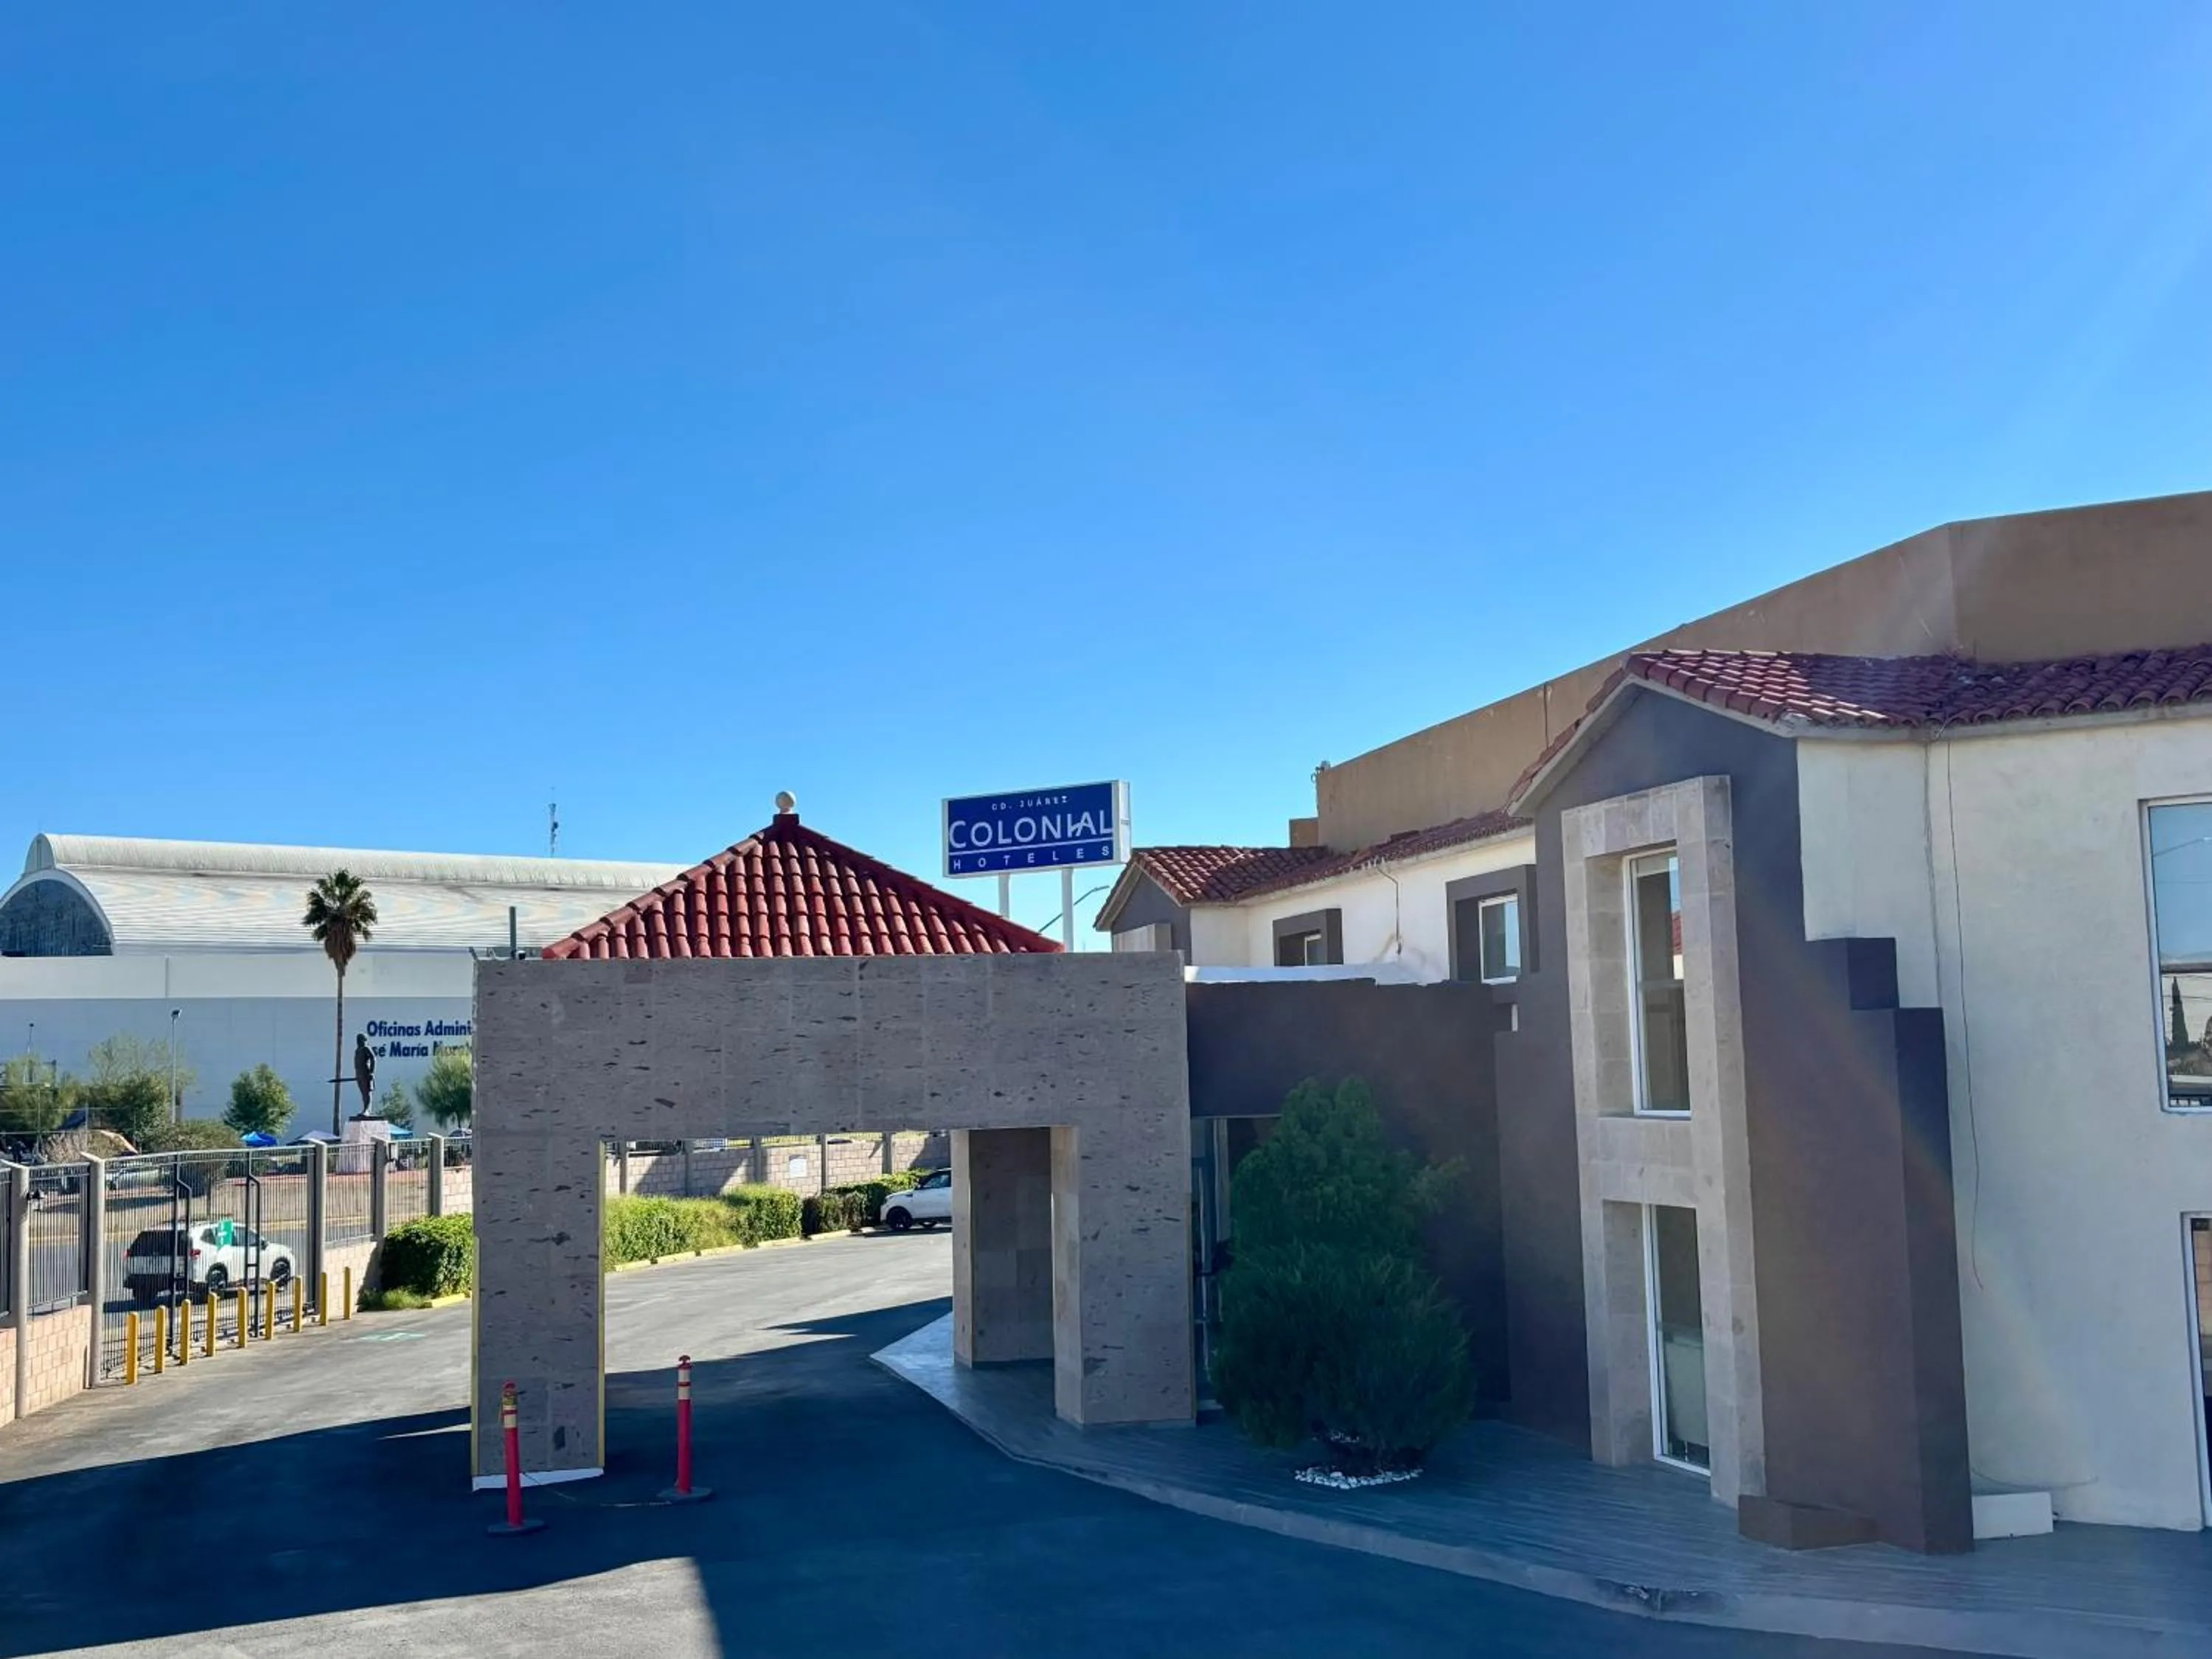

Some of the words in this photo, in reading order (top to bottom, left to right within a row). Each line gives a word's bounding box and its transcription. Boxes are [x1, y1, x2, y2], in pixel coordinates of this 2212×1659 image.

[949, 810, 1113, 848] COLONIAL
[953, 846, 1110, 870] HOTELES
[366, 1020, 421, 1037] Oficinas
[389, 1040, 428, 1057] María
